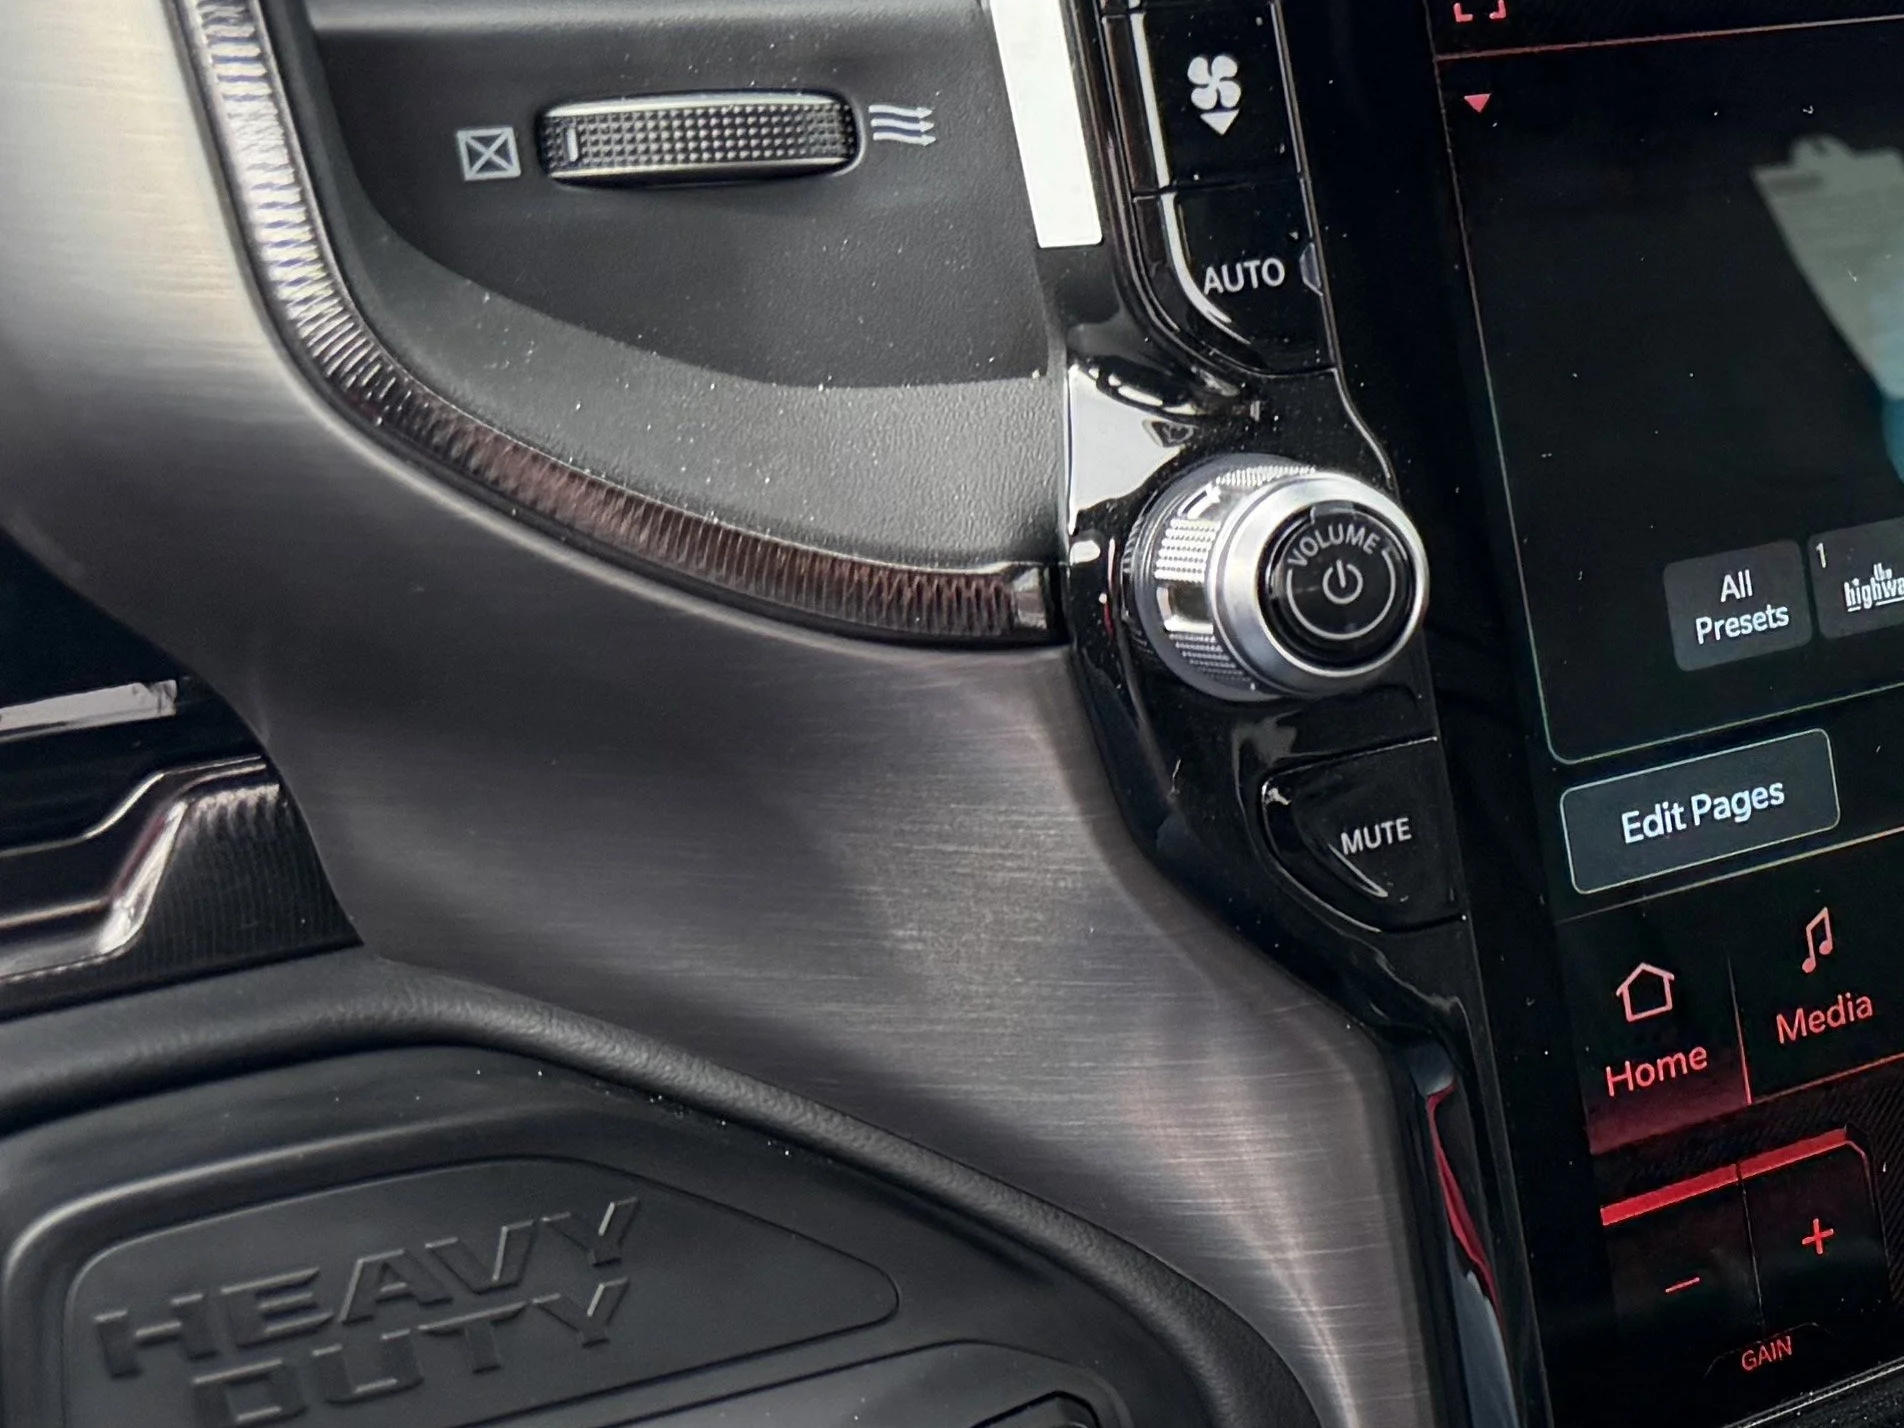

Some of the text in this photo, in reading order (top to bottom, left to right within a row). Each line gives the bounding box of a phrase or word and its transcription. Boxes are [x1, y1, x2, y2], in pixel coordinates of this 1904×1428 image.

[1202, 257, 1286, 297] AUTO
[1287, 523, 1381, 569] VOLUME
[1815, 541, 1828, 569] 1
[1719, 569, 1754, 603] All
[1695, 603, 1790, 645] Presets
[1621, 781, 1785, 845] Edit Pages
[1340, 817, 1413, 856] MUTE
[1775, 992, 1875, 1045] Media
[1604, 1045, 1709, 1098] Home
[94, 1195, 642, 1382] HEAVY
[1740, 1335, 1793, 1372] GAIN
